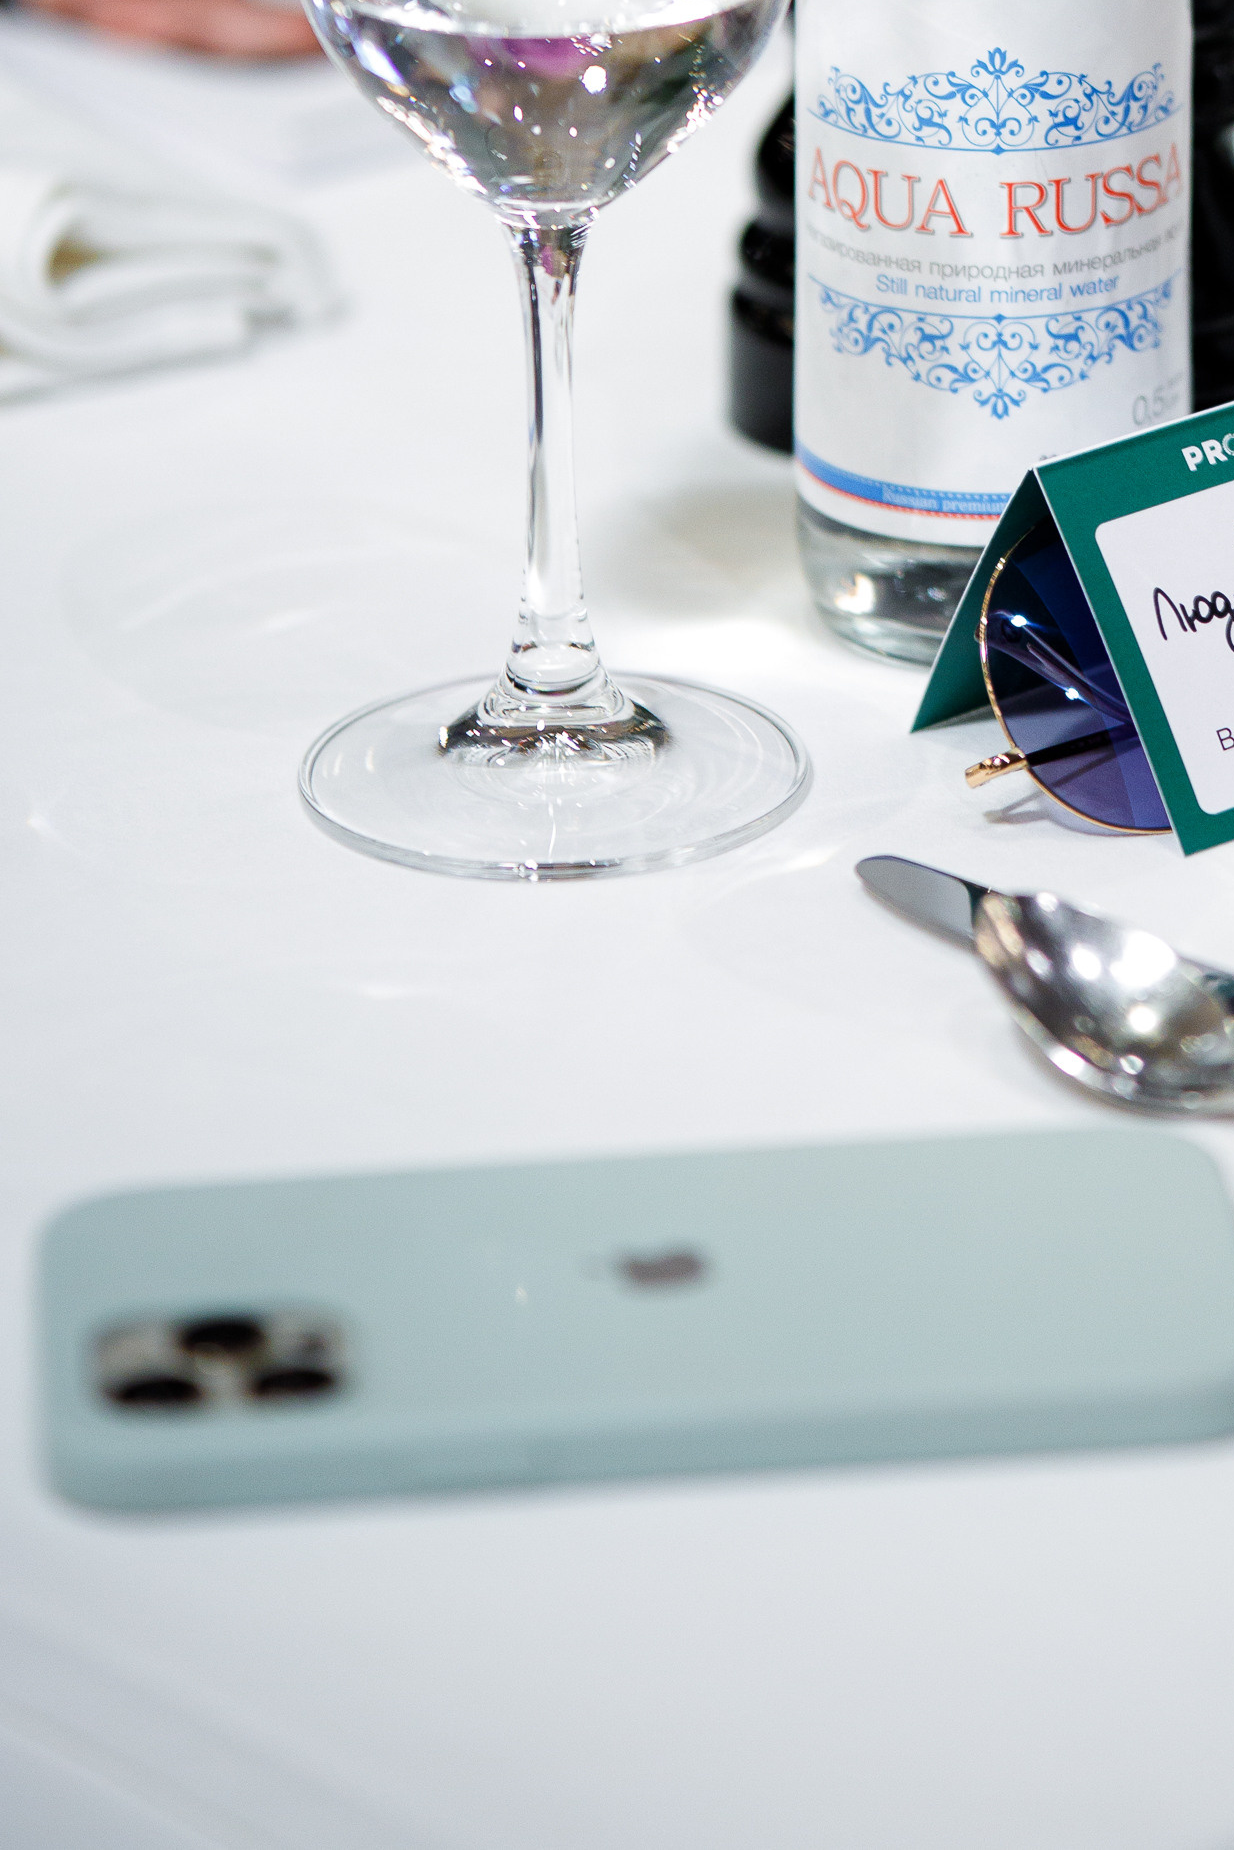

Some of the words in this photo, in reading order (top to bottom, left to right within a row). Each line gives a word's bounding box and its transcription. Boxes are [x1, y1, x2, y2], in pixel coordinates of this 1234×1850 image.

[808, 145, 973, 238] AQUA
[1000, 141, 1182, 238] RUSSA
[929, 260, 1044, 282] природная
[876, 273, 908, 295] Still
[915, 282, 981, 303] natural
[991, 282, 1063, 303] mineral
[1070, 275, 1120, 297] water
